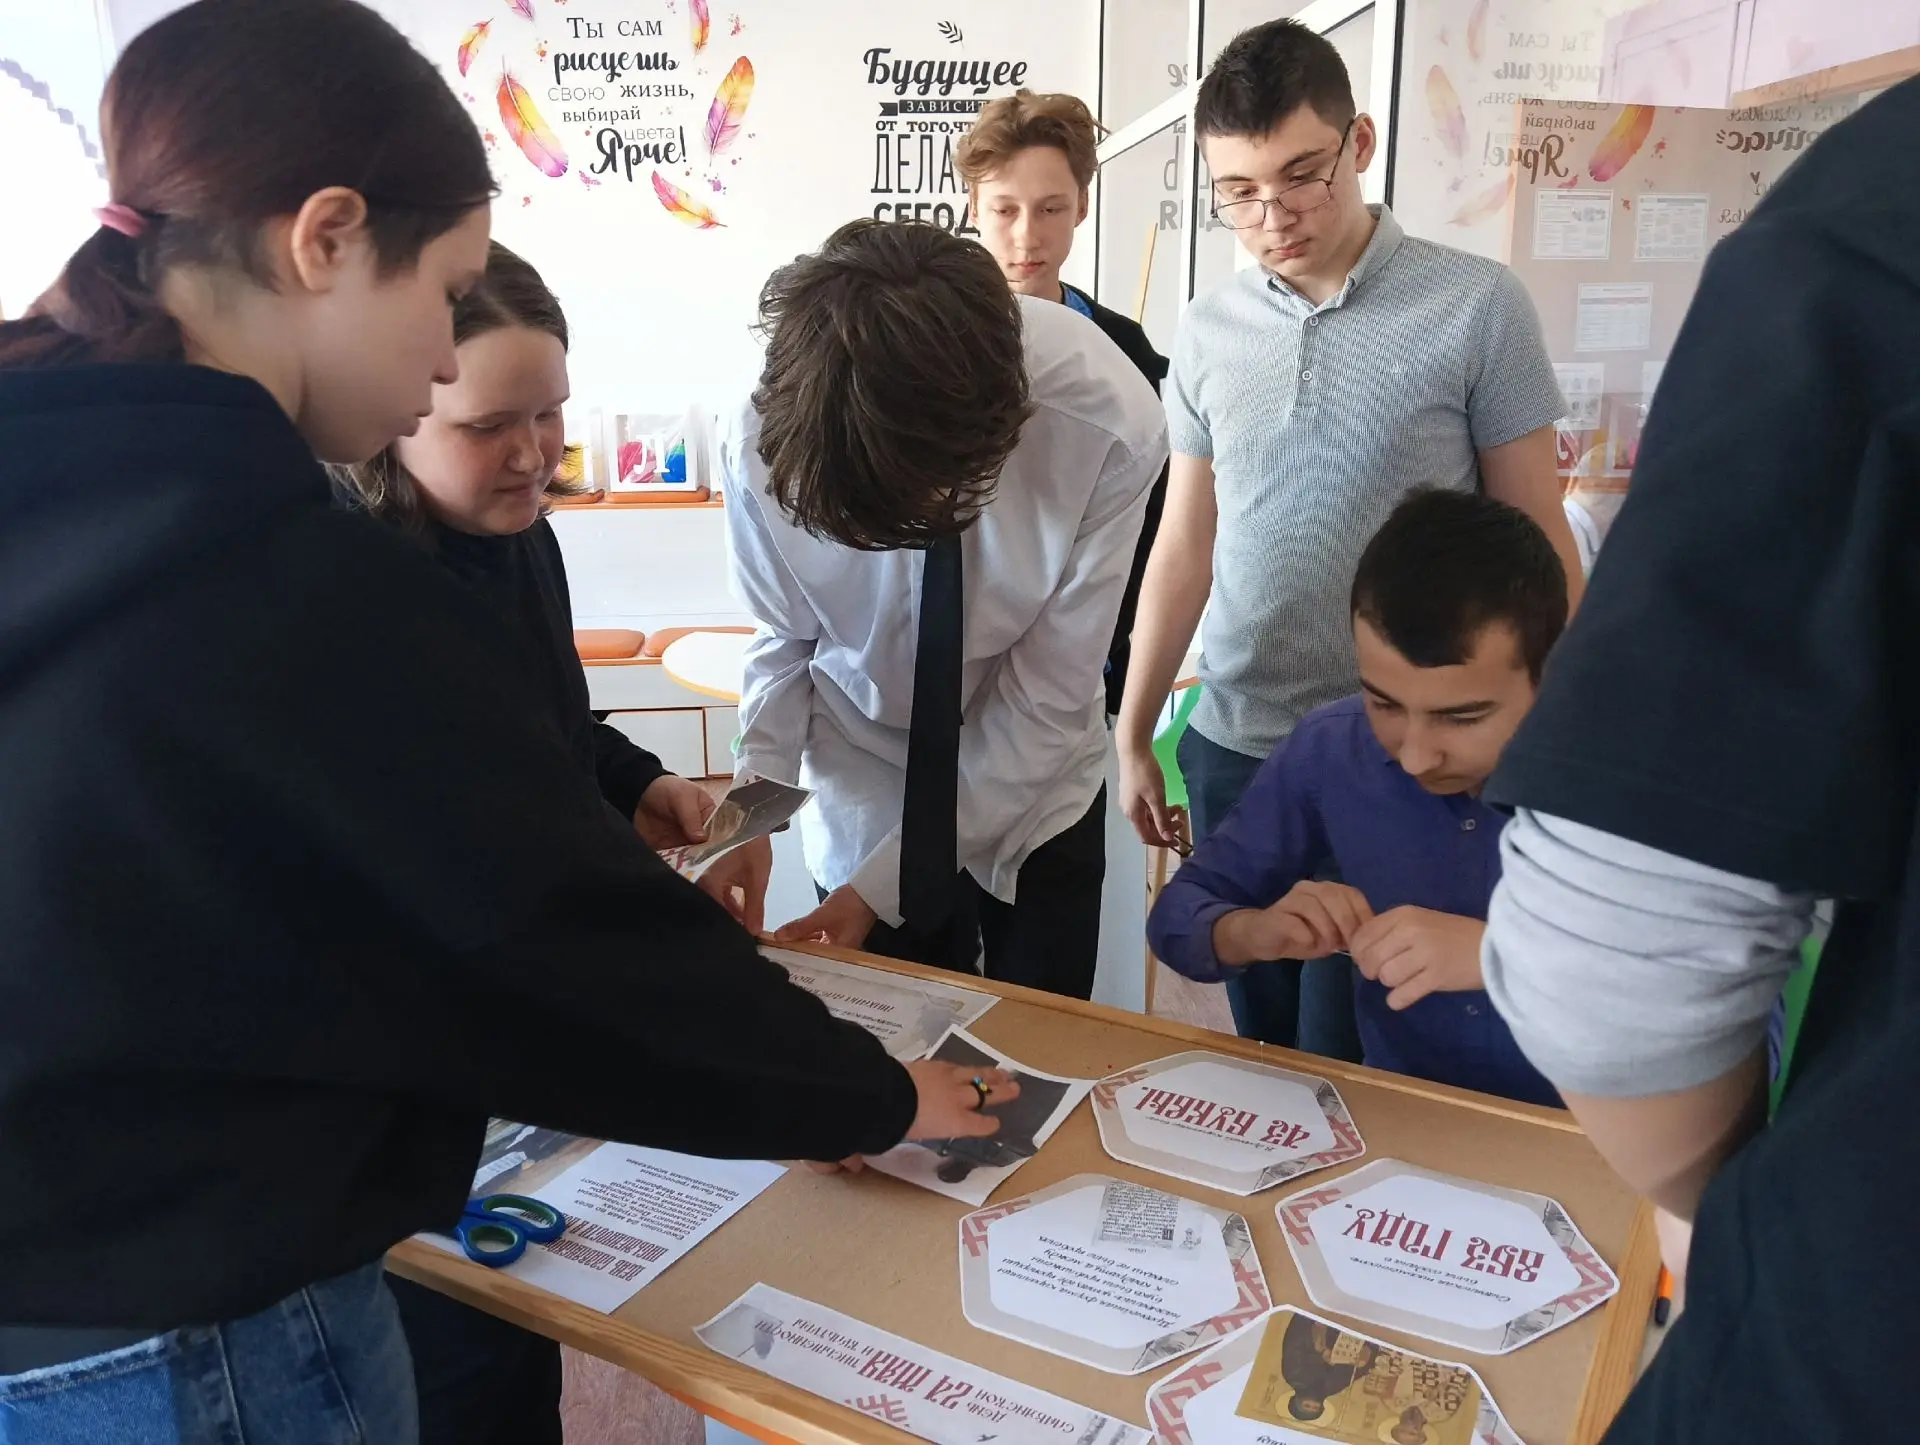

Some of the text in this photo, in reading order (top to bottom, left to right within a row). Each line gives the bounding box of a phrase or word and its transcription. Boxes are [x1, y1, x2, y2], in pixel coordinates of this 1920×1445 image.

[554, 52, 680, 85] рисуешь
[863, 48, 1028, 96] Будущее
[620, 84, 694, 100] жизнь,
[562, 106, 641, 124] выбирай
[624, 127, 675, 141] цвета
[590, 125, 687, 182] Ярче!
[871, 134, 969, 194] ДЕЛА
[874, 202, 980, 238] СЕГОД
[574, 1200, 594, 1208] всех
[602, 1203, 690, 1234] славянских странах
[608, 1212, 625, 1220] мая
[641, 1224, 684, 1240] Ежегодно
[858, 1350, 974, 1410] 24 МАЯ
